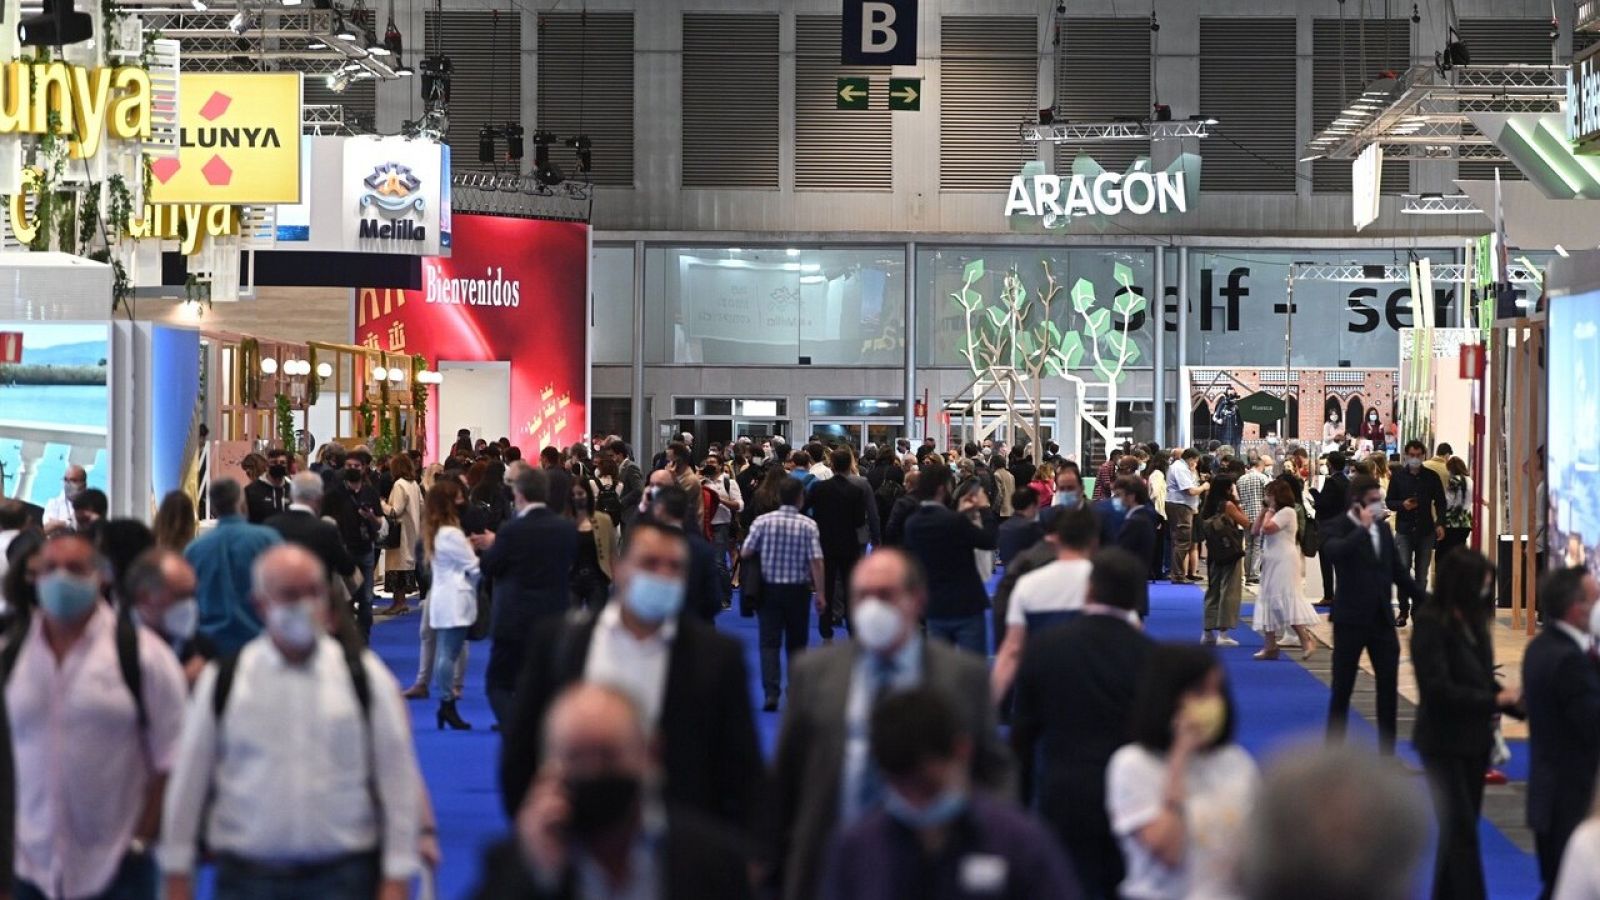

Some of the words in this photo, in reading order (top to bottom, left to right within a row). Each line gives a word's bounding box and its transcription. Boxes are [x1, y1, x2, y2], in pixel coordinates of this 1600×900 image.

[861, 2, 898, 54] B
[1004, 159, 1187, 216] ARAGÓN
[359, 218, 426, 242] Melilla
[425, 264, 520, 308] Bienvenidos
